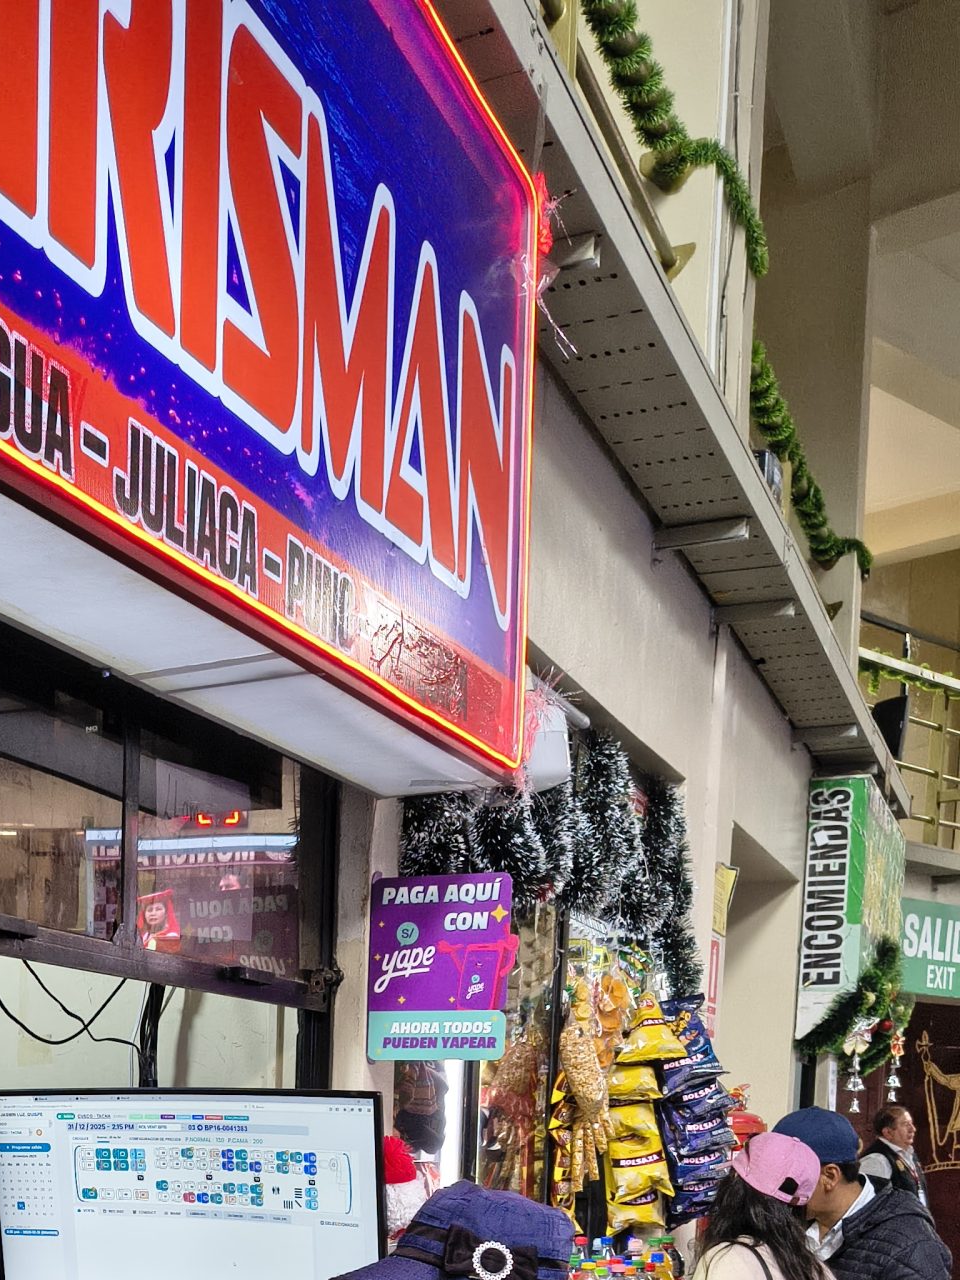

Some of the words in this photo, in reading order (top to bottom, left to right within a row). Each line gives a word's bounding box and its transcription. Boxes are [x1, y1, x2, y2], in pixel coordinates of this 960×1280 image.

[114, 416, 259, 597] JULIACA
[381, 884, 440, 905] PAGA
[443, 878, 503, 905] AQUÍ
[802, 786, 853, 988] ENCOMIENDAS
[444, 911, 489, 931] CON
[401, 928, 414, 938] S/
[373, 945, 436, 993] yape
[926, 964, 956, 991] EXIT
[390, 1021, 441, 1034] AHORA
[442, 1020, 493, 1034] TODOS
[382, 1037, 438, 1049] PUEDEN
[441, 1037, 497, 1049] YAPEAR
[619, 1153, 660, 1167] BOLSAZA
